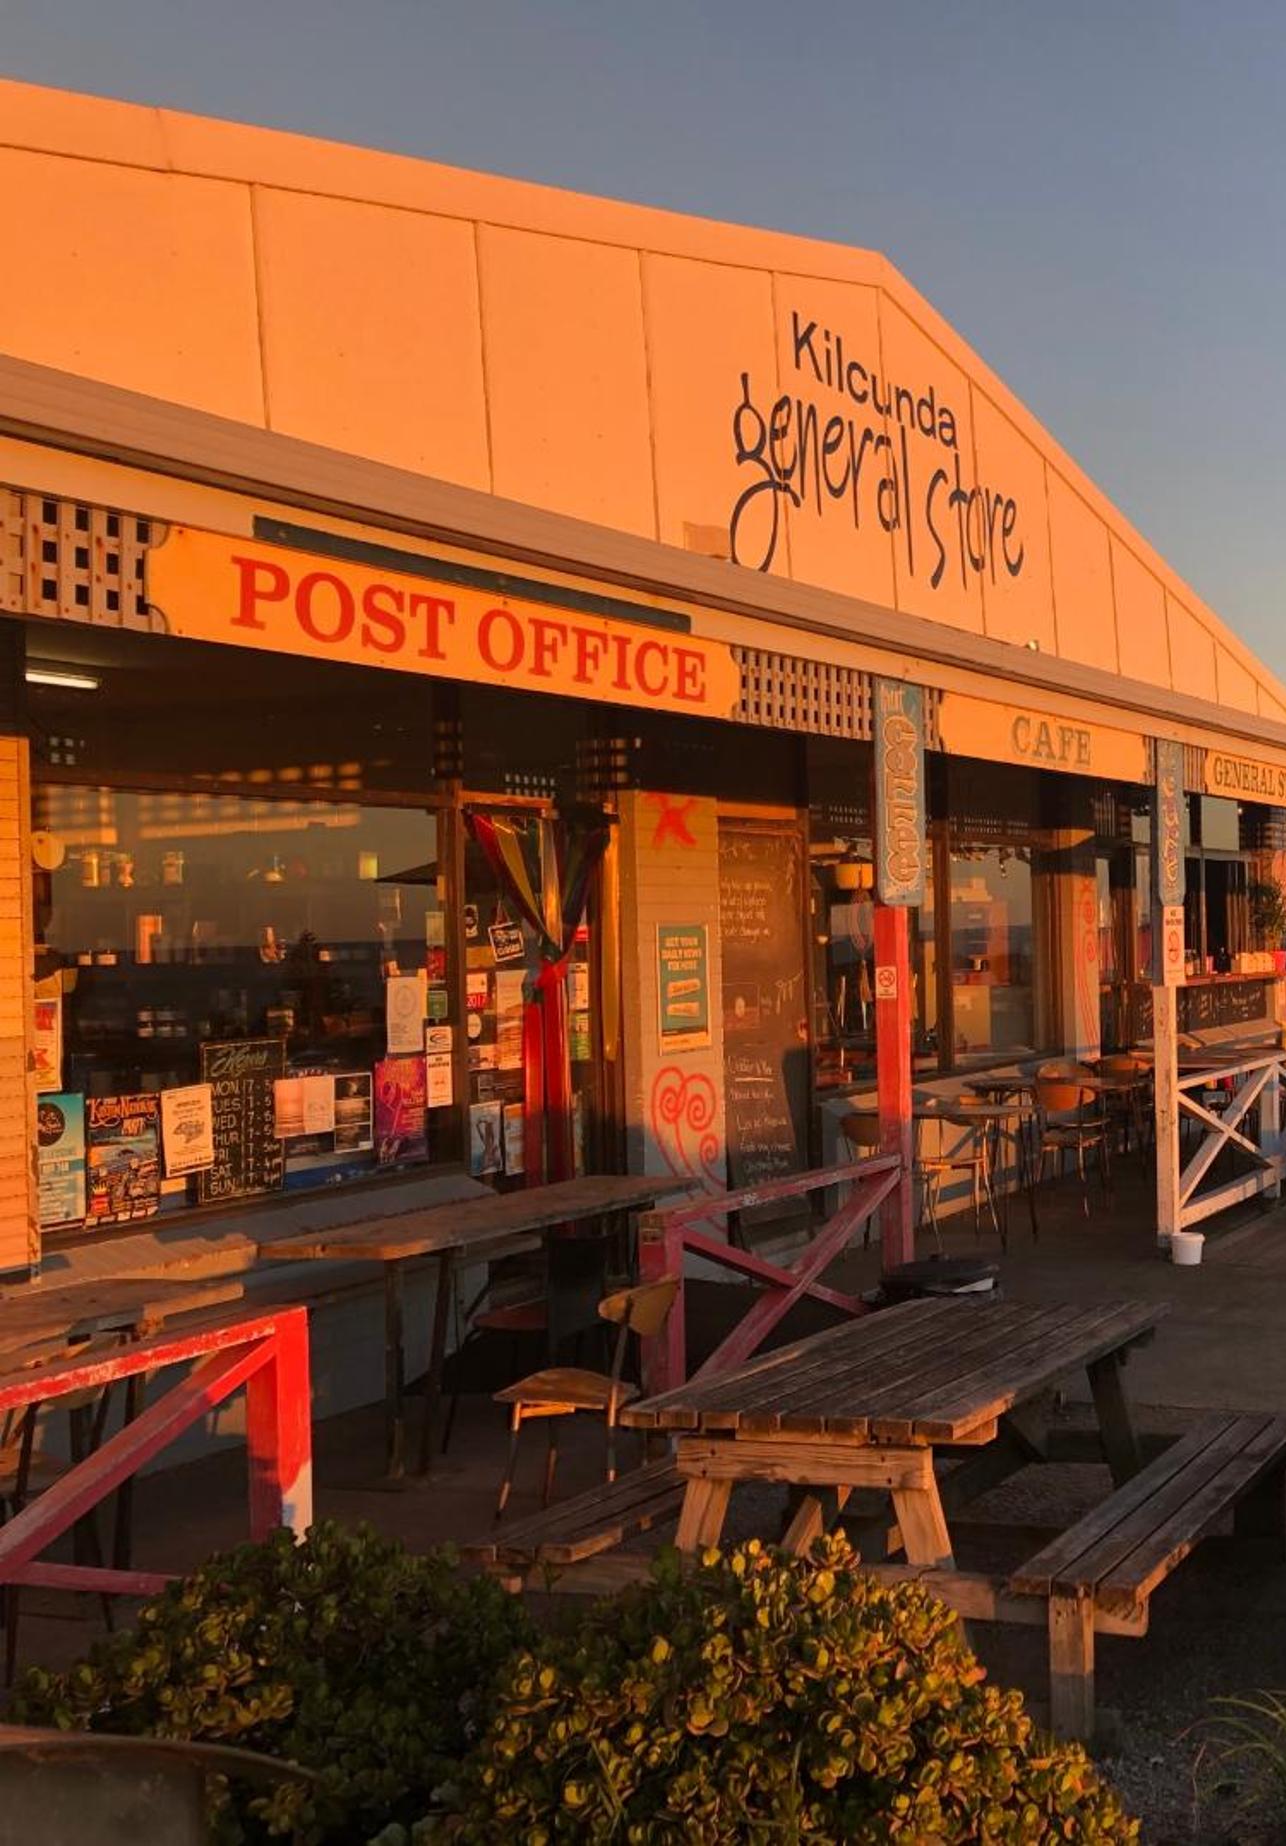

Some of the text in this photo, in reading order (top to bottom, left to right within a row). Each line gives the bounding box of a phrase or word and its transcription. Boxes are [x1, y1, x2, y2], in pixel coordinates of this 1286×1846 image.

[792, 311, 958, 449] Kilcunda
[730, 372, 1024, 589] general store
[230, 555, 706, 703] POST OFFICE
[1012, 715, 1091, 766] CAFE
[1213, 756, 1275, 796] GENERAL
[214, 1099, 241, 1112] UES
